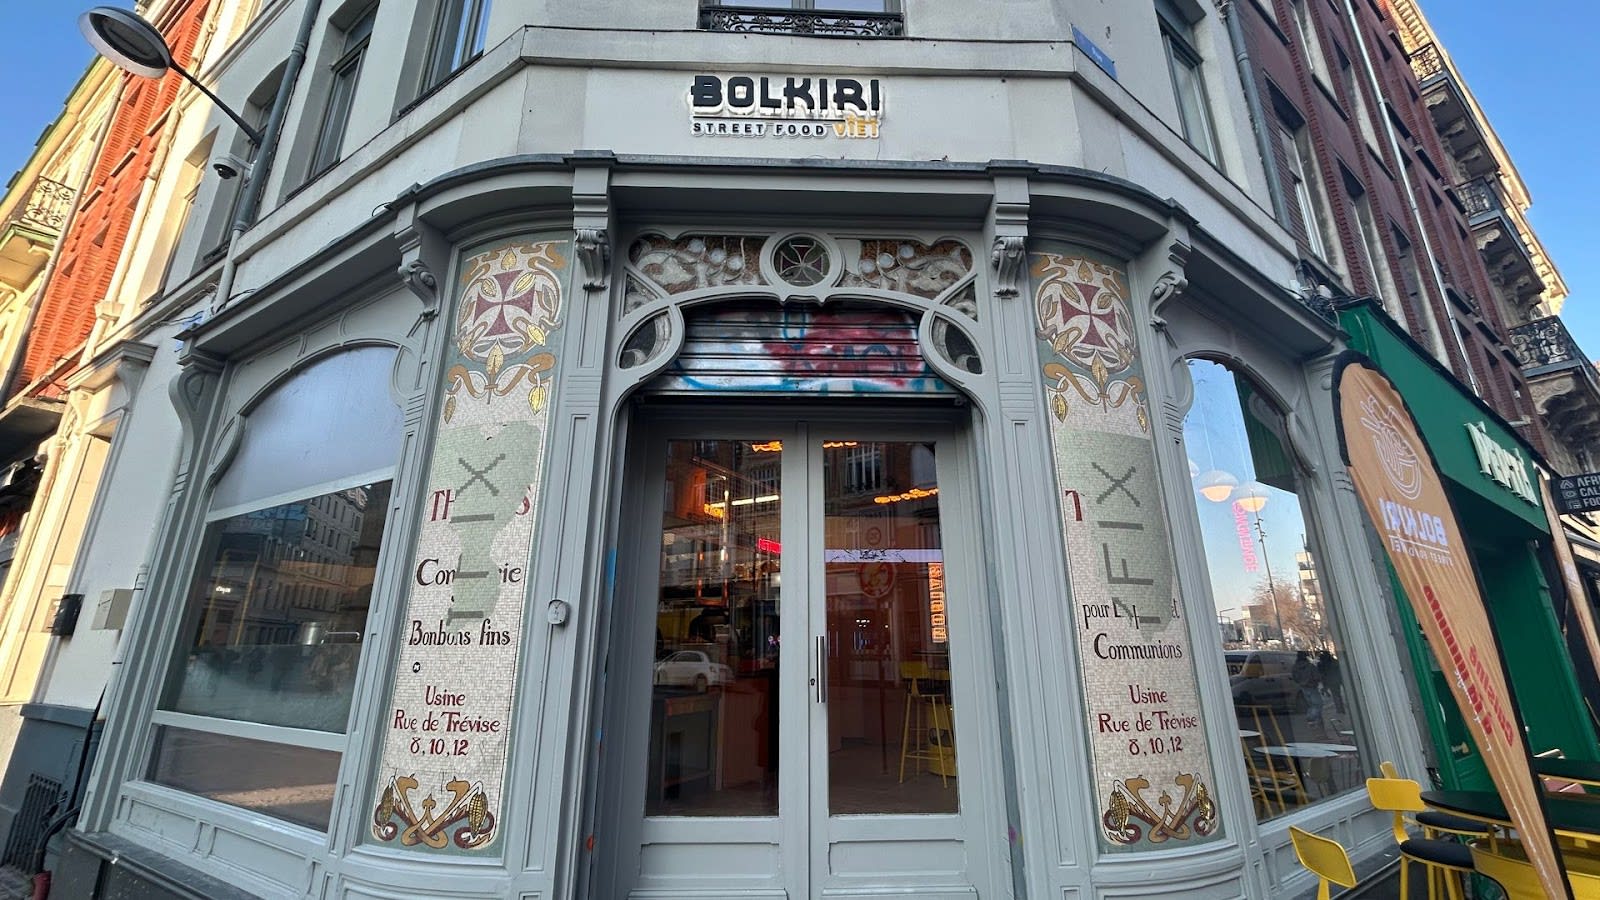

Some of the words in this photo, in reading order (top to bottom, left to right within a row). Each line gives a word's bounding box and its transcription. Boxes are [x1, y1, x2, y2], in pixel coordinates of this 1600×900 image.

[691, 75, 880, 112] BOLKIRI
[693, 122, 764, 134] STREET
[775, 124, 825, 136] FOOD
[834, 117, 879, 137] VIET
[1580, 487, 1600, 497] CAL
[1083, 604, 1110, 630] pour
[479, 618, 511, 646] fins
[1094, 632, 1183, 660] Communions
[425, 685, 466, 706] Usine
[1129, 685, 1168, 705] Usine
[394, 709, 417, 731] Rue
[422, 711, 438, 731] de
[440, 712, 500, 733] Trévise
[1098, 713, 1130, 733] Rue
[1136, 712, 1151, 732] de
[1152, 710, 1197, 730] Trévise
